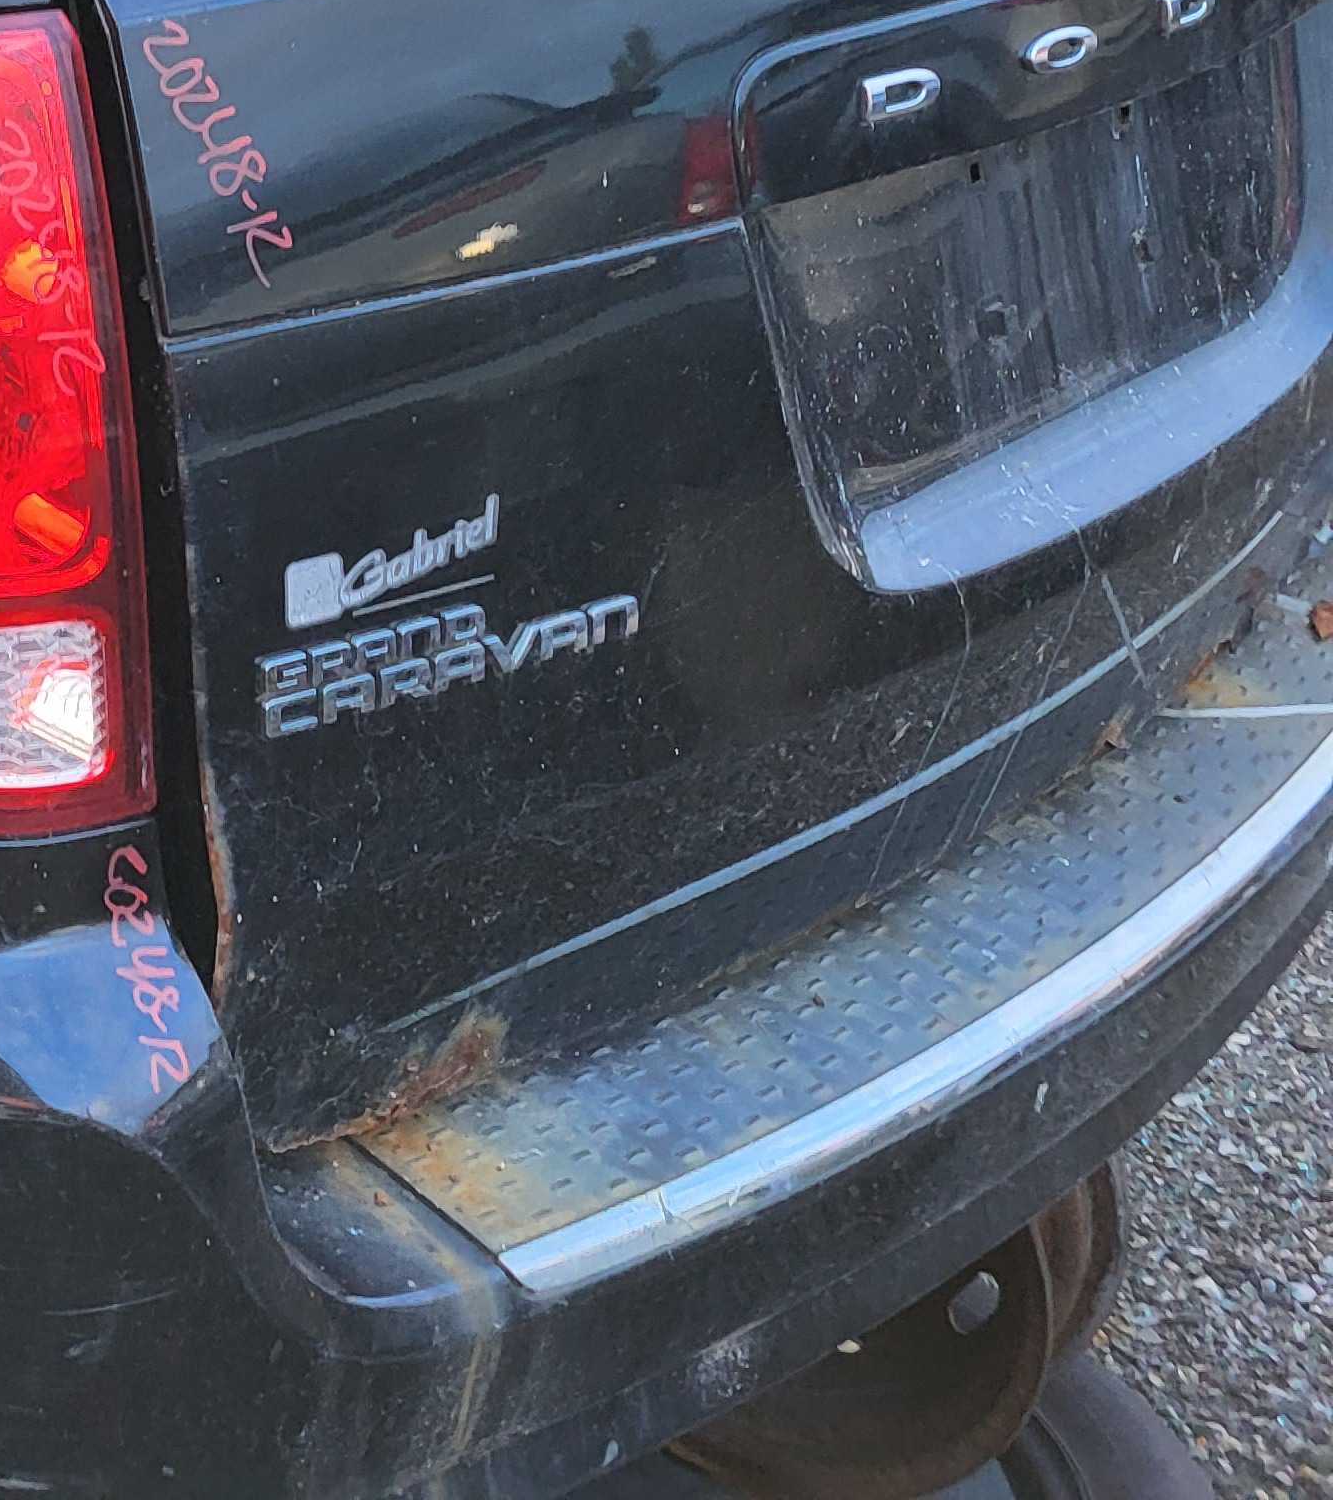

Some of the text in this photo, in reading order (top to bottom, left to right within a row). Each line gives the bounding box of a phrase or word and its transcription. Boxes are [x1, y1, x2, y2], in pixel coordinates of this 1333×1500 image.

[340, 492, 501, 607] Gabriel
[255, 602, 487, 696] GRAND
[259, 593, 641, 741] CARAVAN
